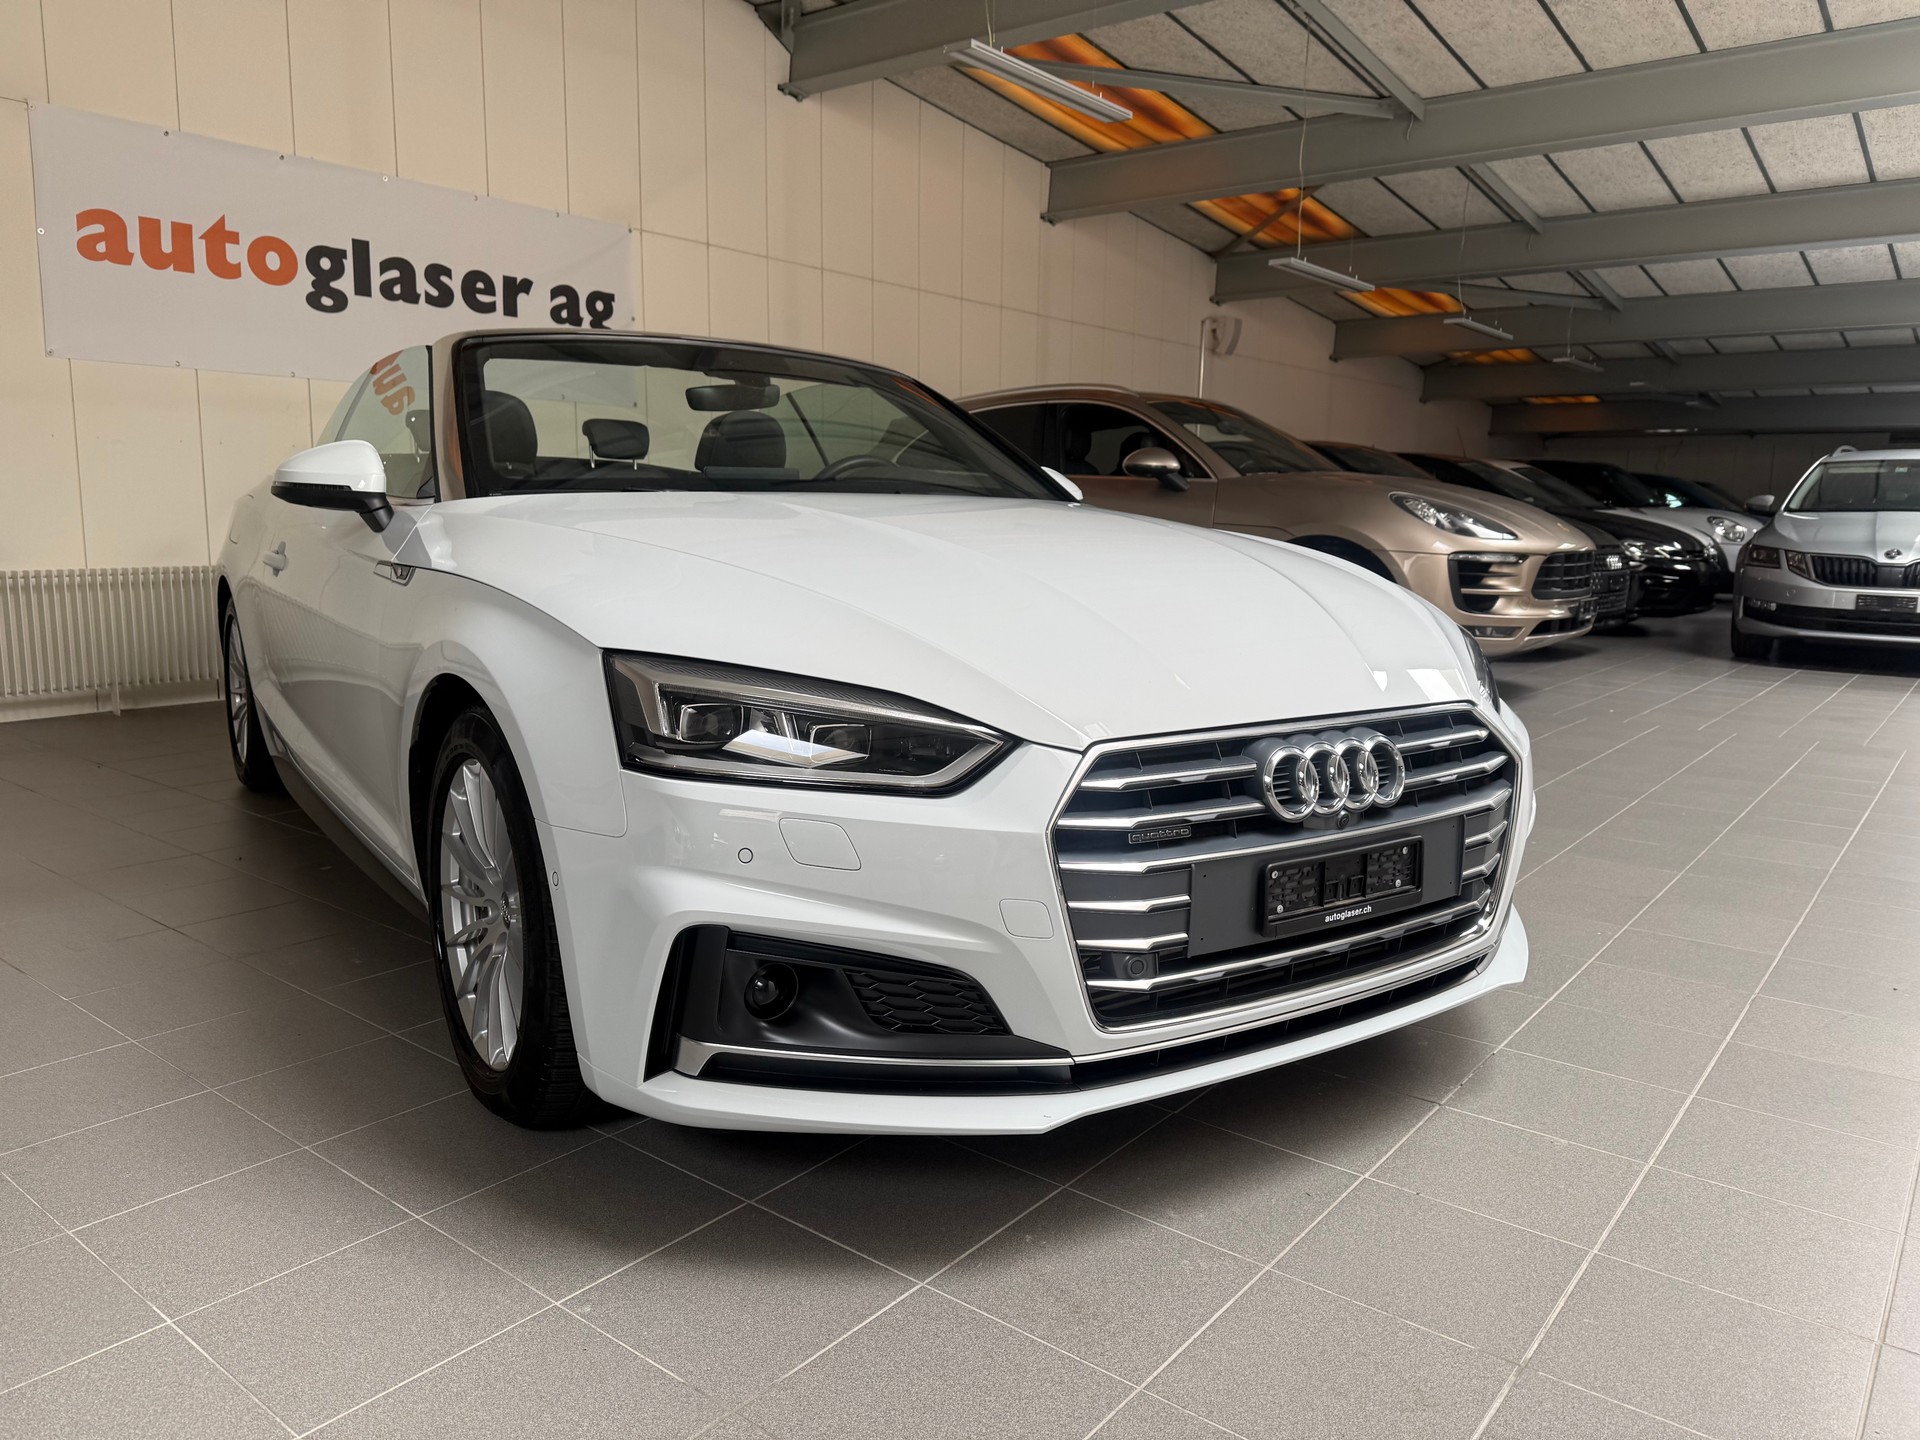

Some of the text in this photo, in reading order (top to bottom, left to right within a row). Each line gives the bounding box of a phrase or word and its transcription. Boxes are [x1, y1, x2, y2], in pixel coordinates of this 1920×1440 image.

[76, 208, 615, 329] autoglaser ag
[1131, 828, 1190, 842] quattro
[1324, 904, 1372, 923] autoglaser.ch
